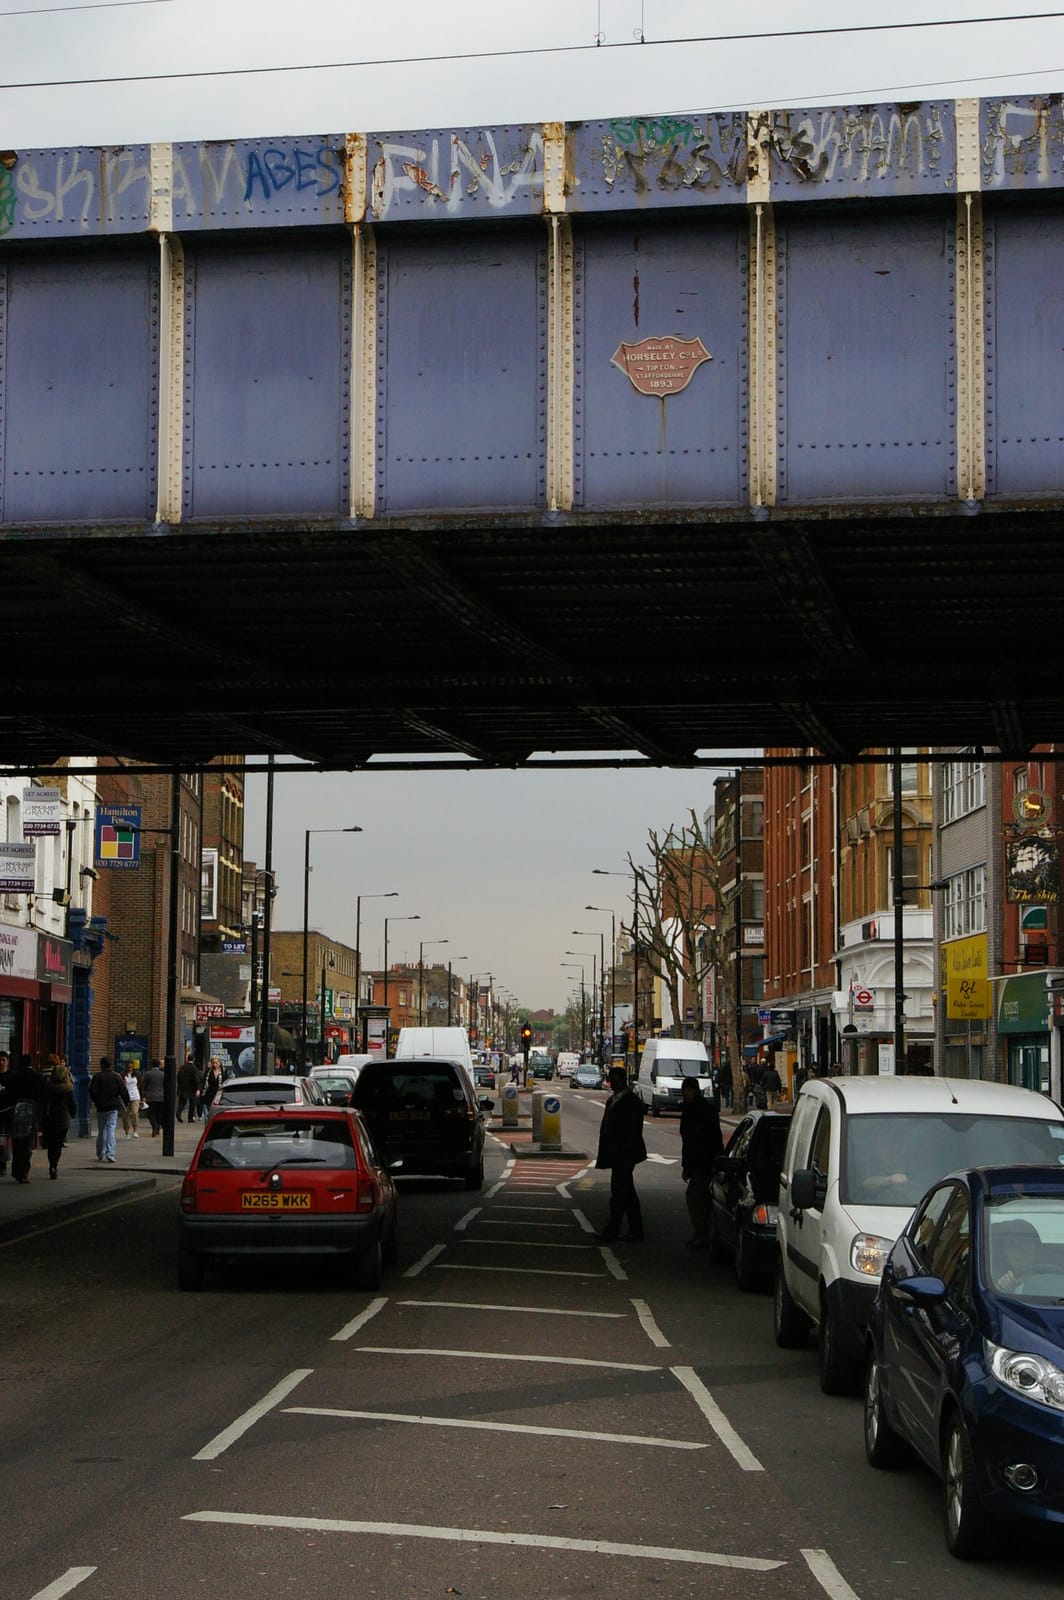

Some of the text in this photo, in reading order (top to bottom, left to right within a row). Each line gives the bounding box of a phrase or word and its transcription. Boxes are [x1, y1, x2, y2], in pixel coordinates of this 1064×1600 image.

[623, 351, 676, 362] HORSELEY
[650, 380, 673, 388] 1893
[25, 808, 55, 816] GRANT
[100, 807, 138, 816] Hamilton
[243, 1194, 309, 1207] N265 WKK
